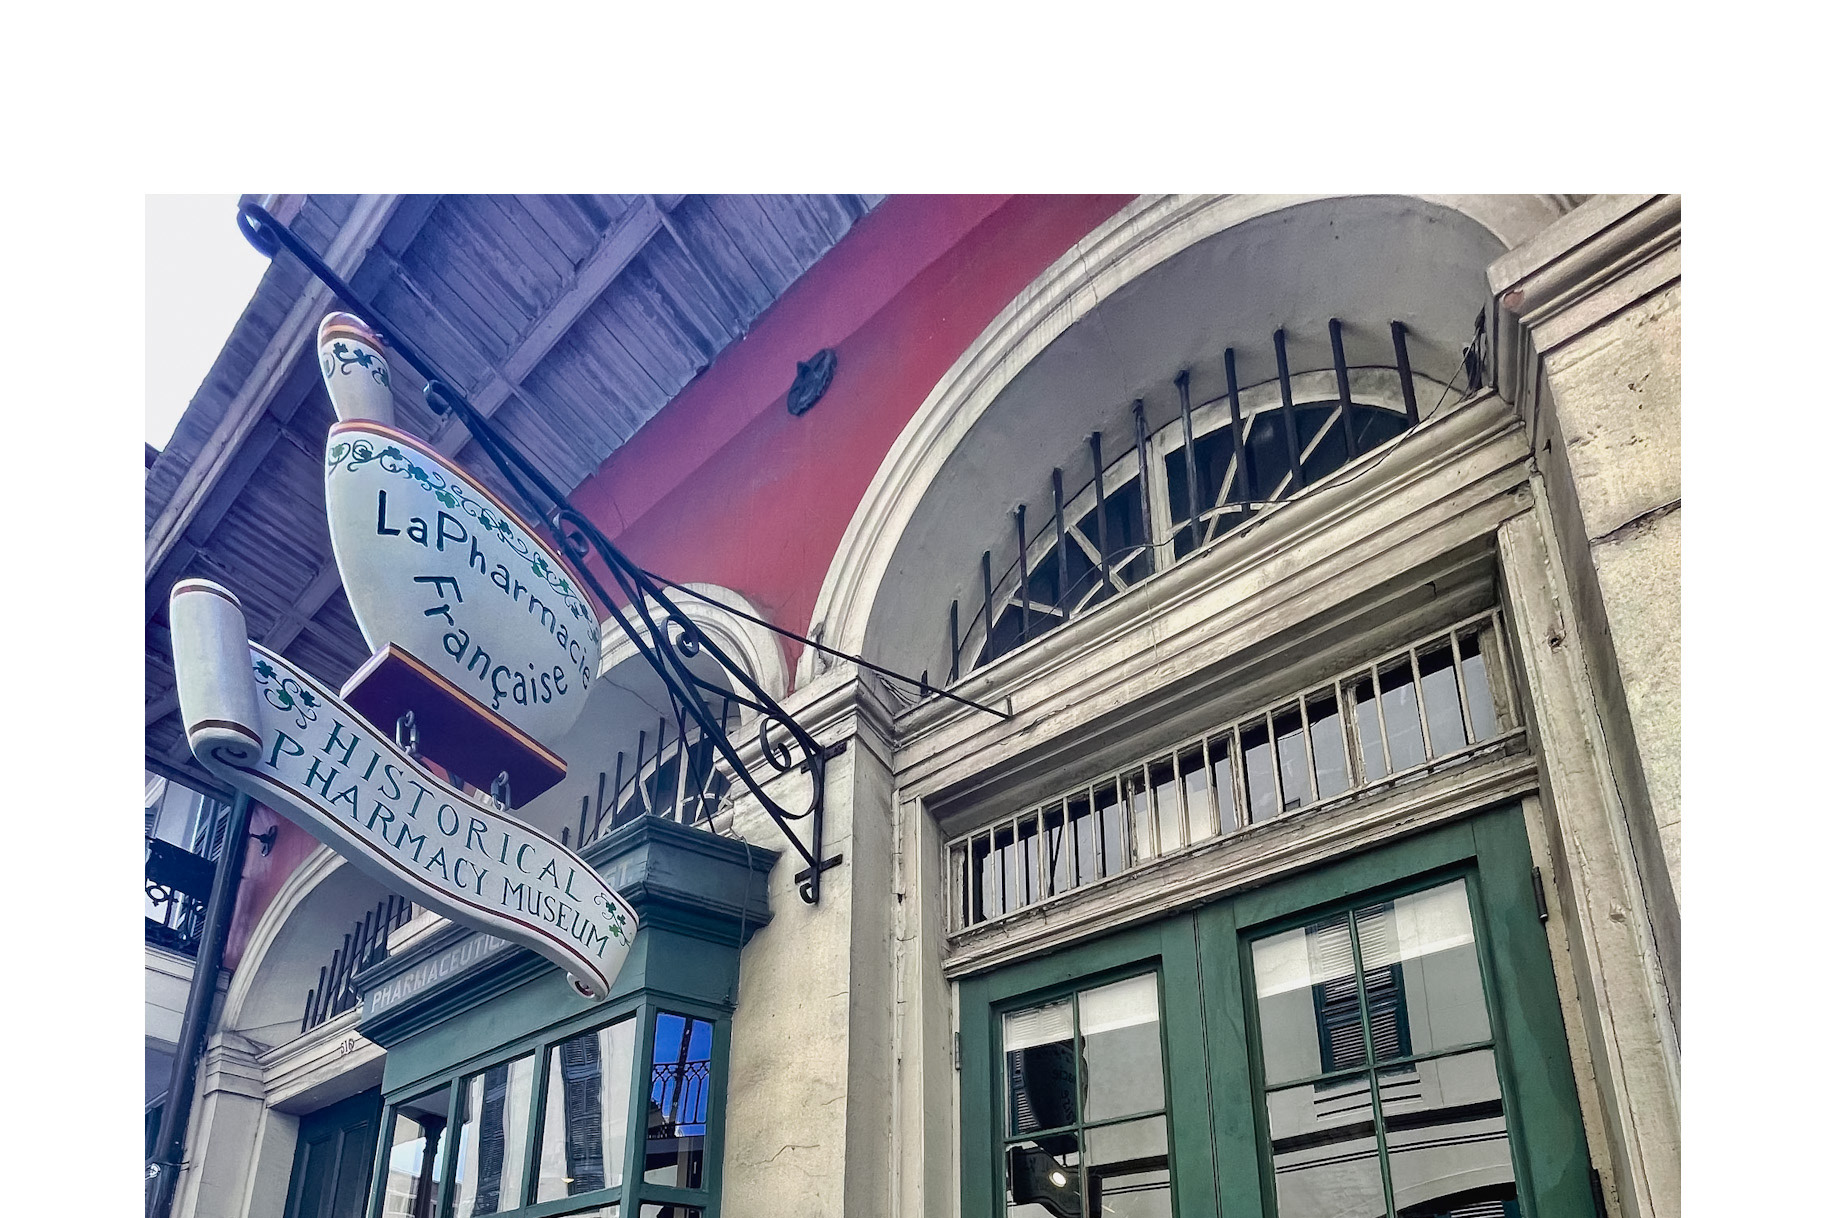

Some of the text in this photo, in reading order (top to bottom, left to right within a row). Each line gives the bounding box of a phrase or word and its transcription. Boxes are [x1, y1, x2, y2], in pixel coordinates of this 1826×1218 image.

[413, 576, 569, 710] Française
[264, 729, 610, 960] PHARMACY MUSEUM
[320, 718, 582, 902] HISTORICAL
